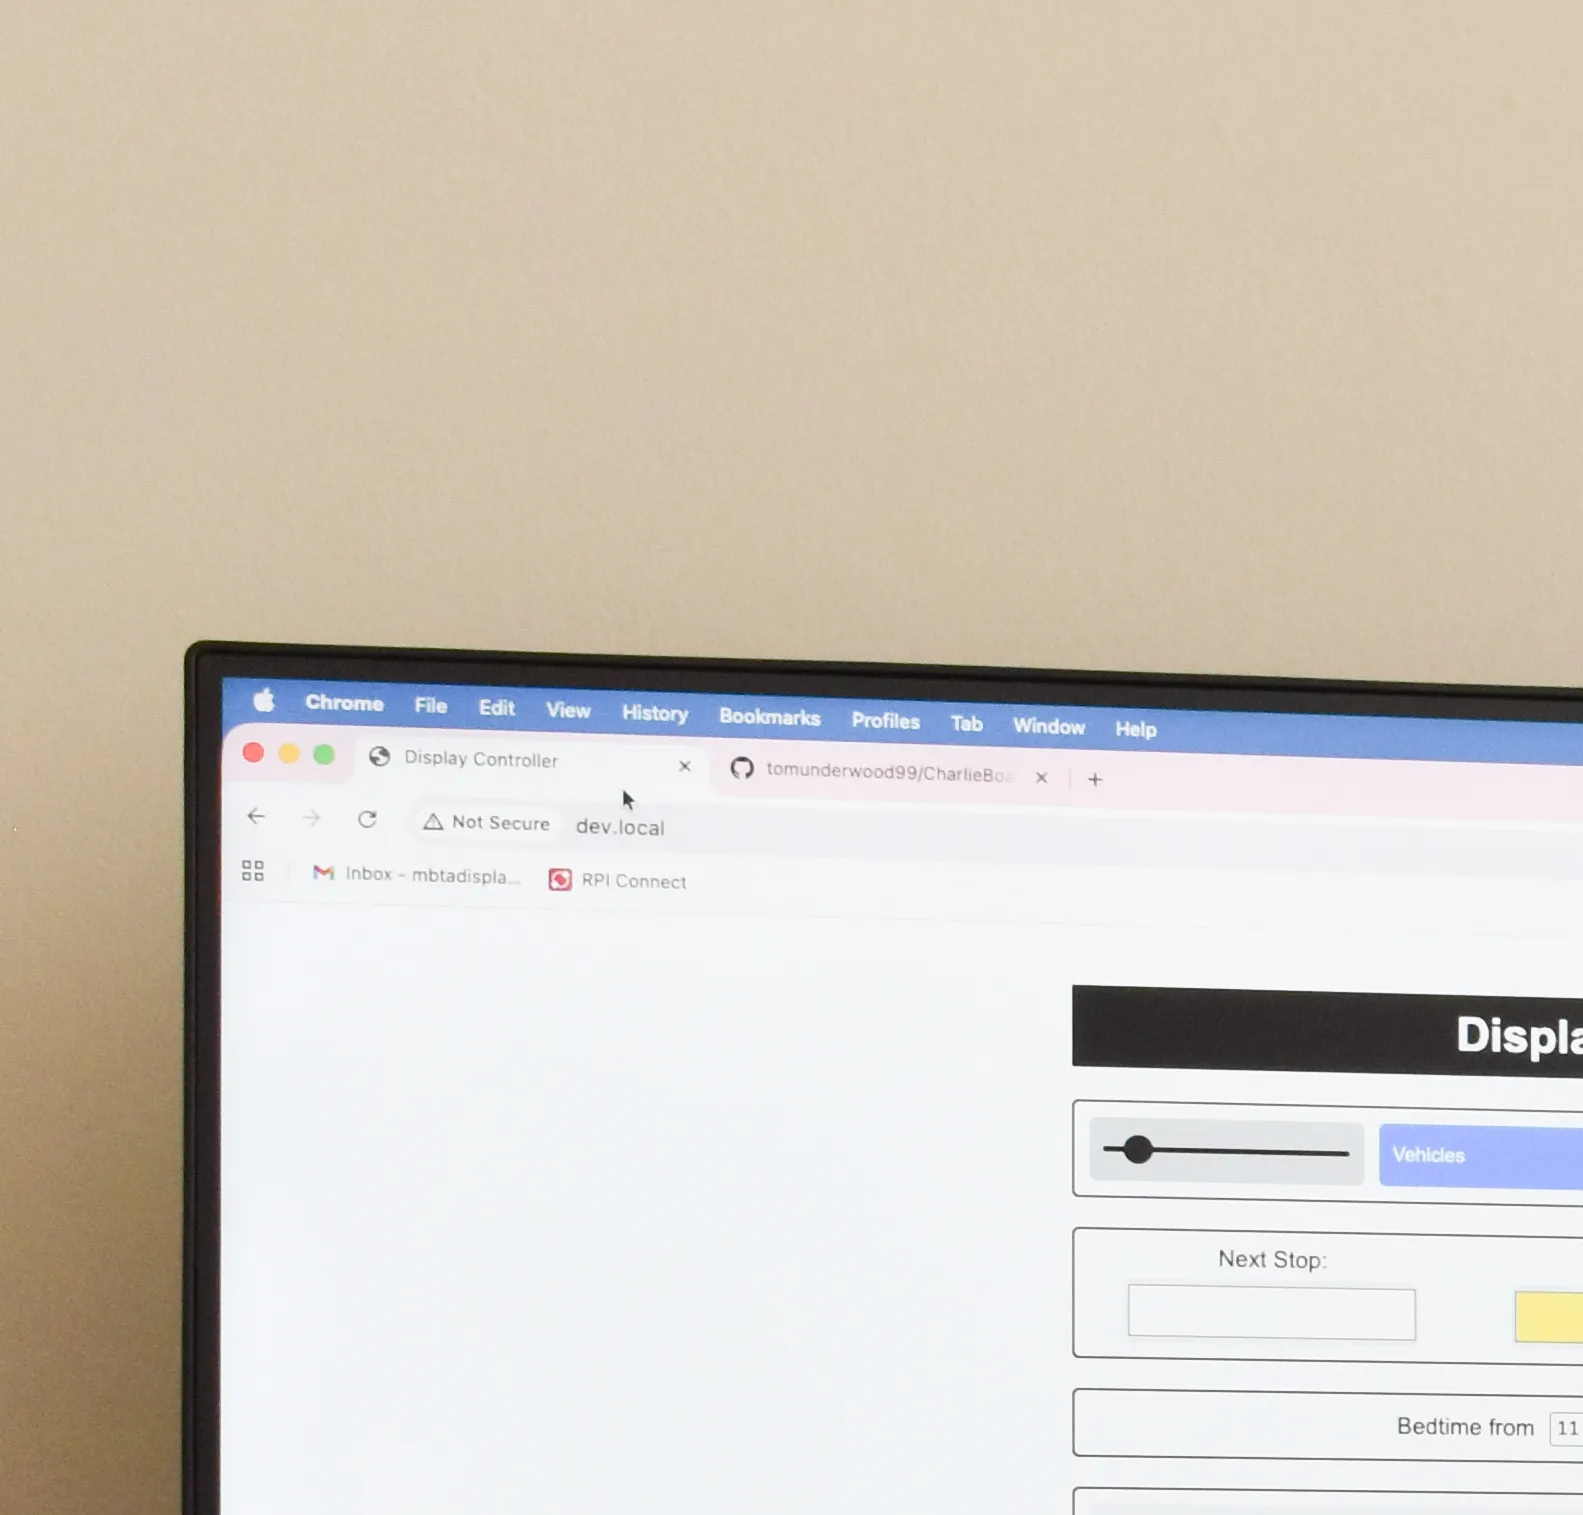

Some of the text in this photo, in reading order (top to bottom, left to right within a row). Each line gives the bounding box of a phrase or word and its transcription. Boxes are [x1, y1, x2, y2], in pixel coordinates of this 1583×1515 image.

[306, 694, 1157, 740] Chrome File Edit View History Bookmarks Profiles Tab Window Help
[404, 749, 559, 769] Display Controller
[452, 814, 551, 832] Not Secure
[576, 818, 665, 837] dev.local
[346, 866, 392, 881] Inbox
[582, 872, 687, 890] RPI Connect
[1392, 1145, 1466, 1164] Vehicles
[1219, 1249, 1328, 1274] Next Stop:
[1397, 1416, 1535, 1437] Bedtime from
